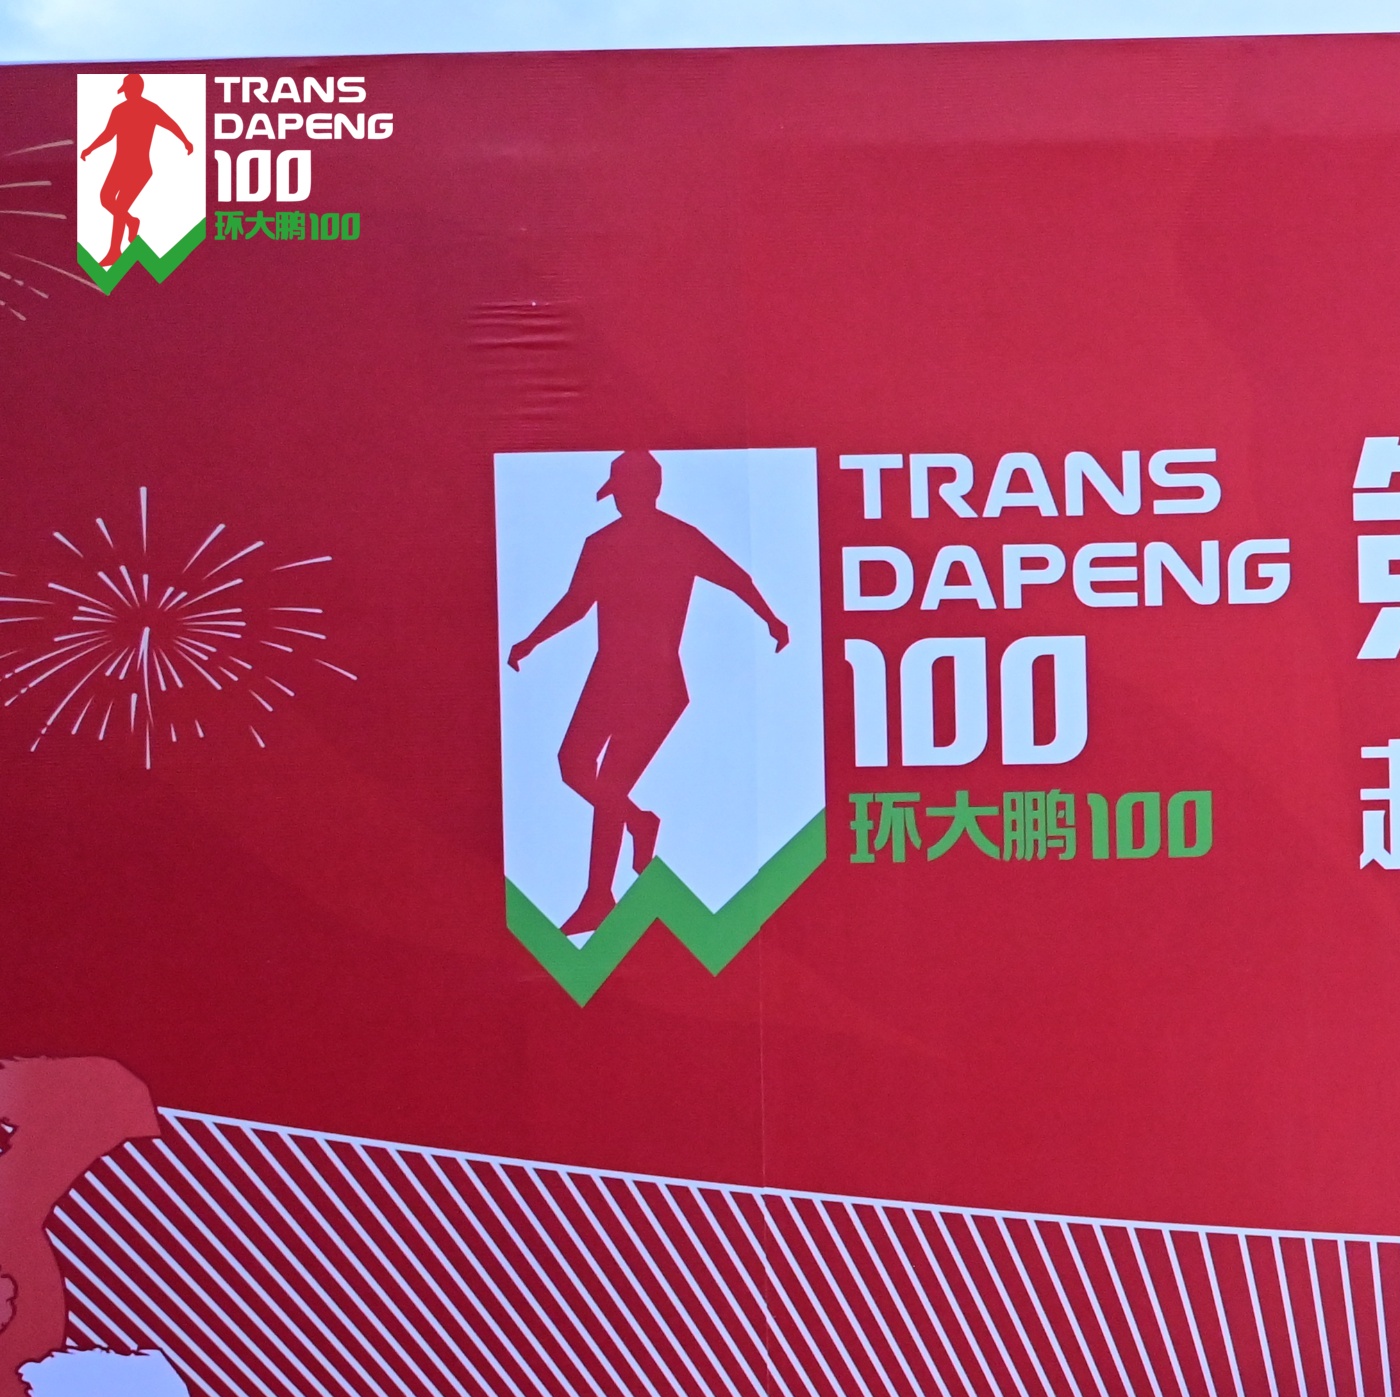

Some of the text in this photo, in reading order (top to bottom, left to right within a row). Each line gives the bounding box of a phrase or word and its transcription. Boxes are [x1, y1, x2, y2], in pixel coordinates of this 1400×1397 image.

[838, 447, 1223, 520] TRANS
[841, 537, 1292, 612] DAPENG
[844, 634, 1088, 768] 100
[849, 789, 1214, 864] 环大鹏100
